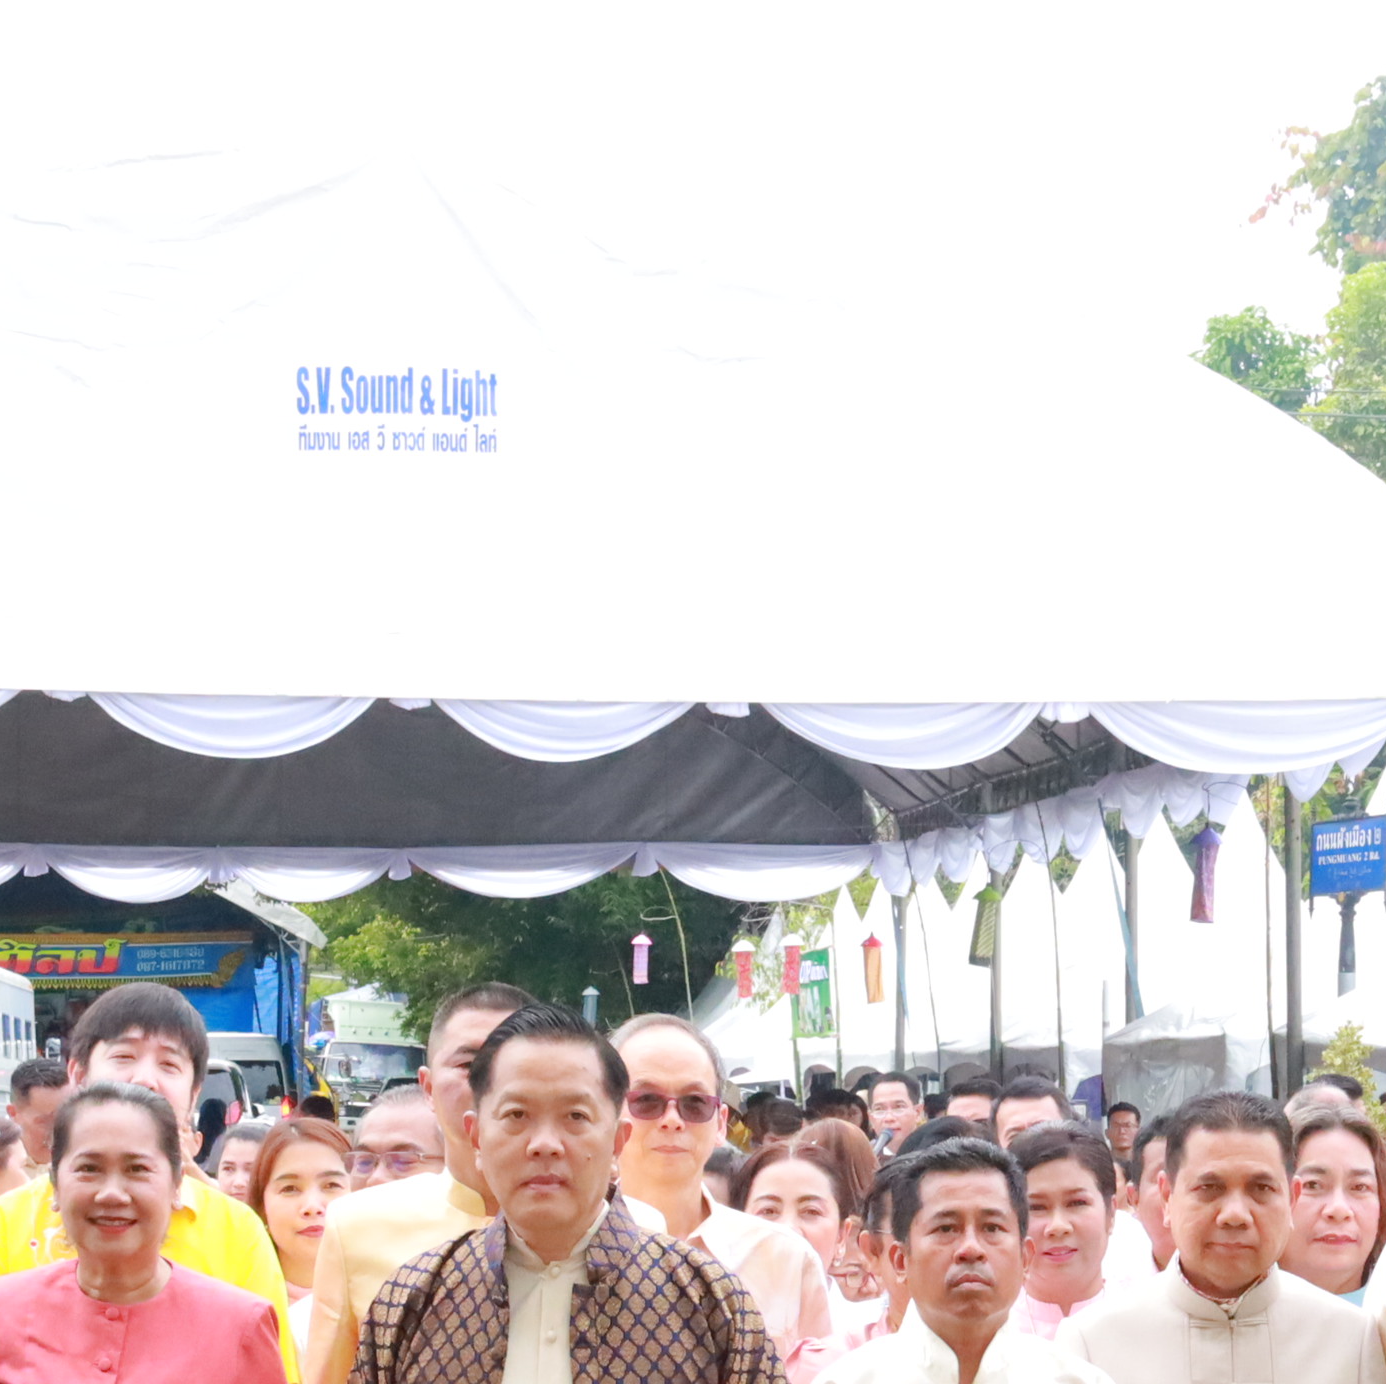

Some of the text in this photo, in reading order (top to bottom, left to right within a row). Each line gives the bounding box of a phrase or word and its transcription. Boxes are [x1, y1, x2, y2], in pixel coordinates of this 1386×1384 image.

[296, 365, 498, 423] S.V. Sound & Light
[347, 431, 370, 451] เอส
